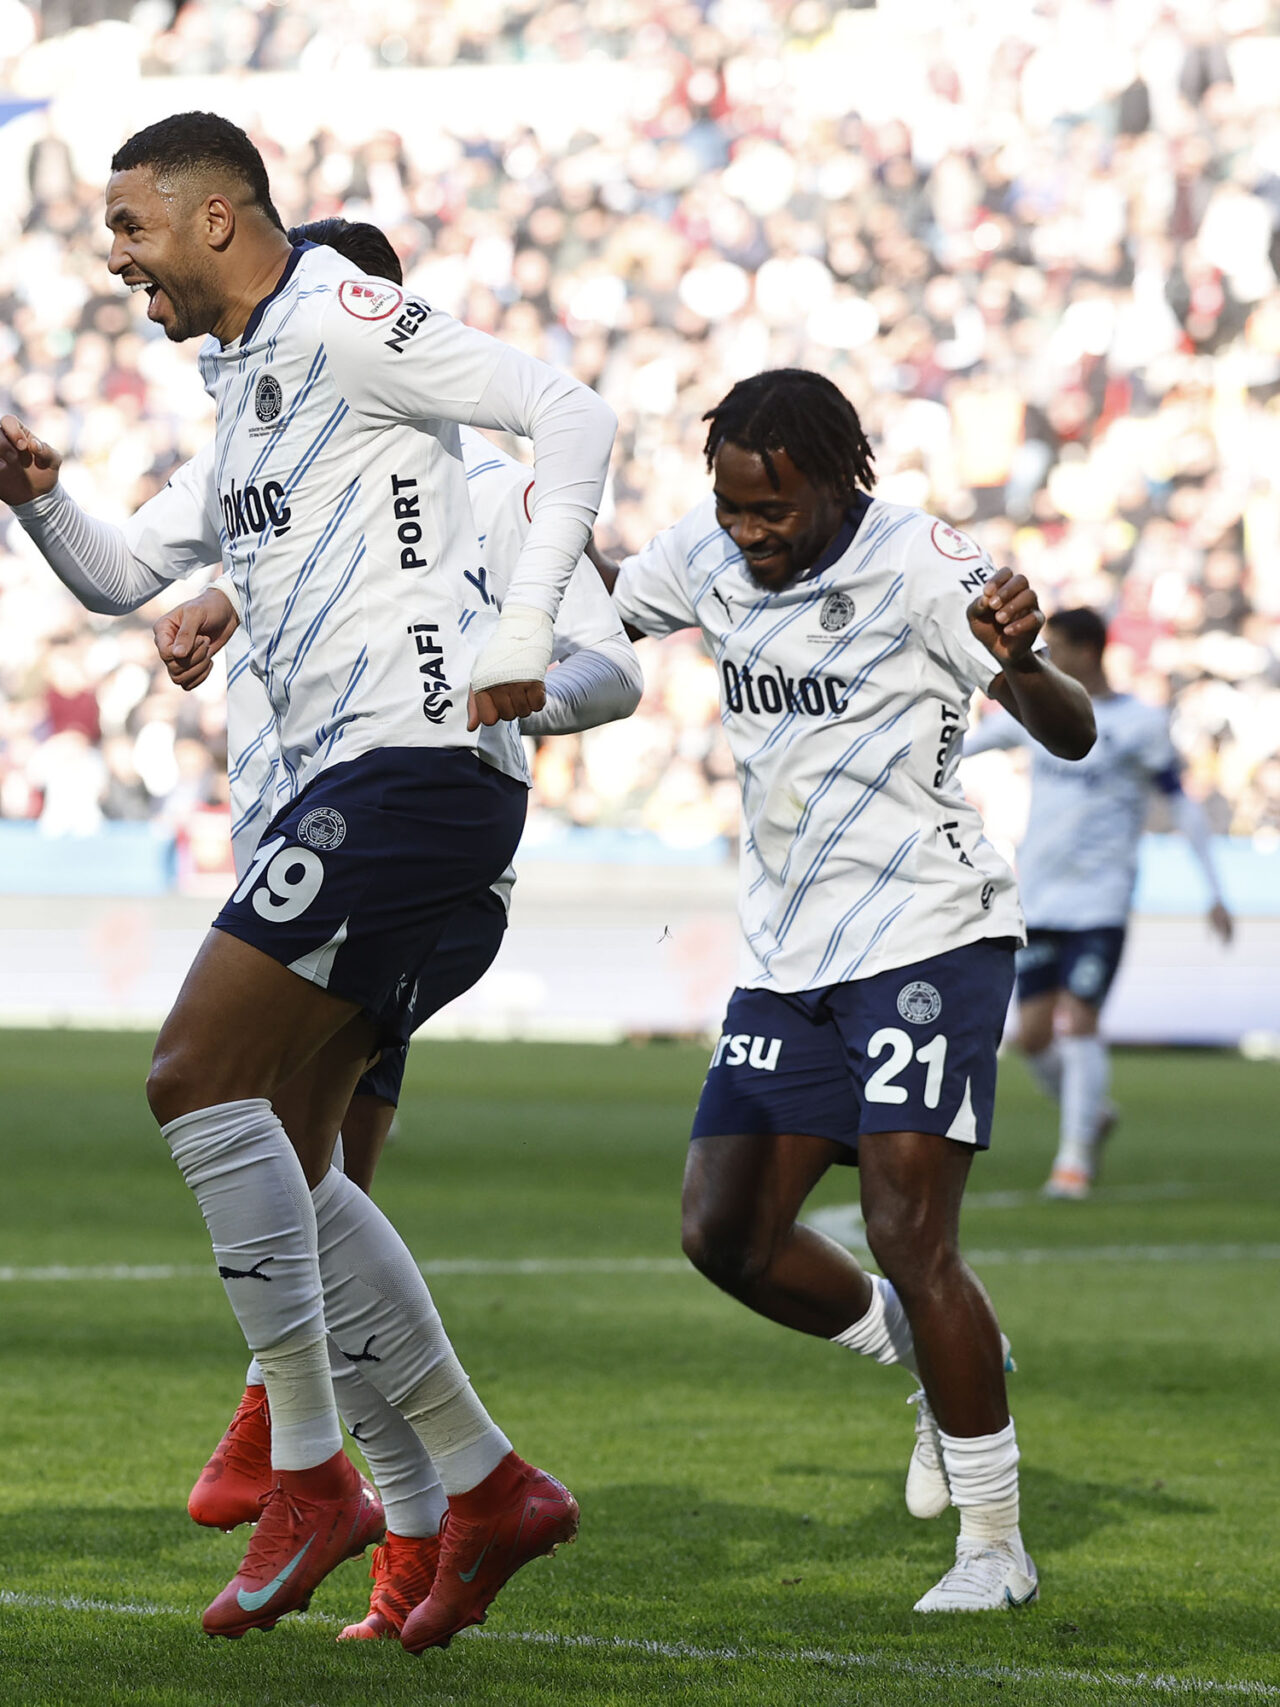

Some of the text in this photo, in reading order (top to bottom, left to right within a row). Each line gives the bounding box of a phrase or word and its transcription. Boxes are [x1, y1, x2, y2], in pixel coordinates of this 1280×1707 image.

[384, 301, 432, 354] NES
[391, 474, 428, 570] PORT
[464, 566, 495, 605] Y
[960, 567, 988, 594] NE
[232, 834, 324, 923] 19
[709, 1033, 783, 1072] rsu
[864, 1027, 948, 1110] 21
